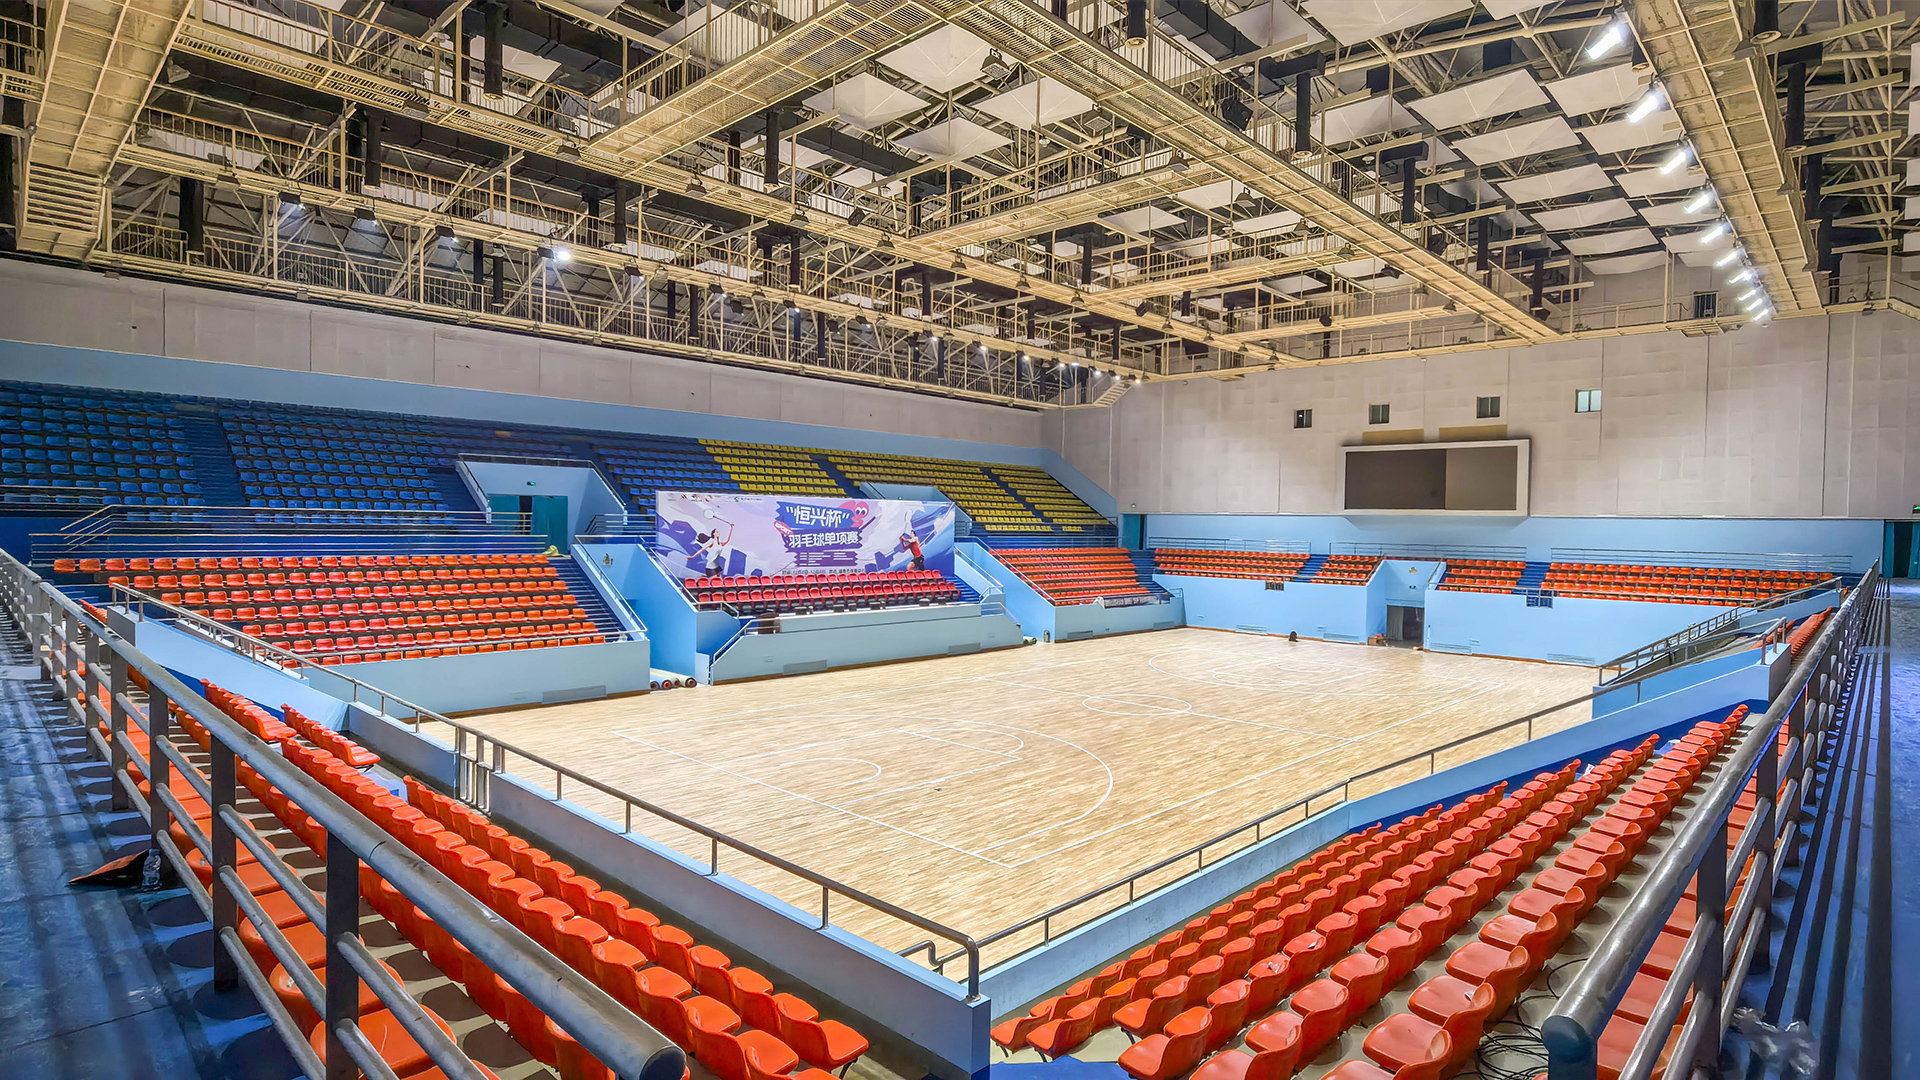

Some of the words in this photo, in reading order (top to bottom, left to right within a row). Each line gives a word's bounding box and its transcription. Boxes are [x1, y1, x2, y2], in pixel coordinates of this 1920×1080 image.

[789, 531, 859, 548] 羽毛球单项赛
